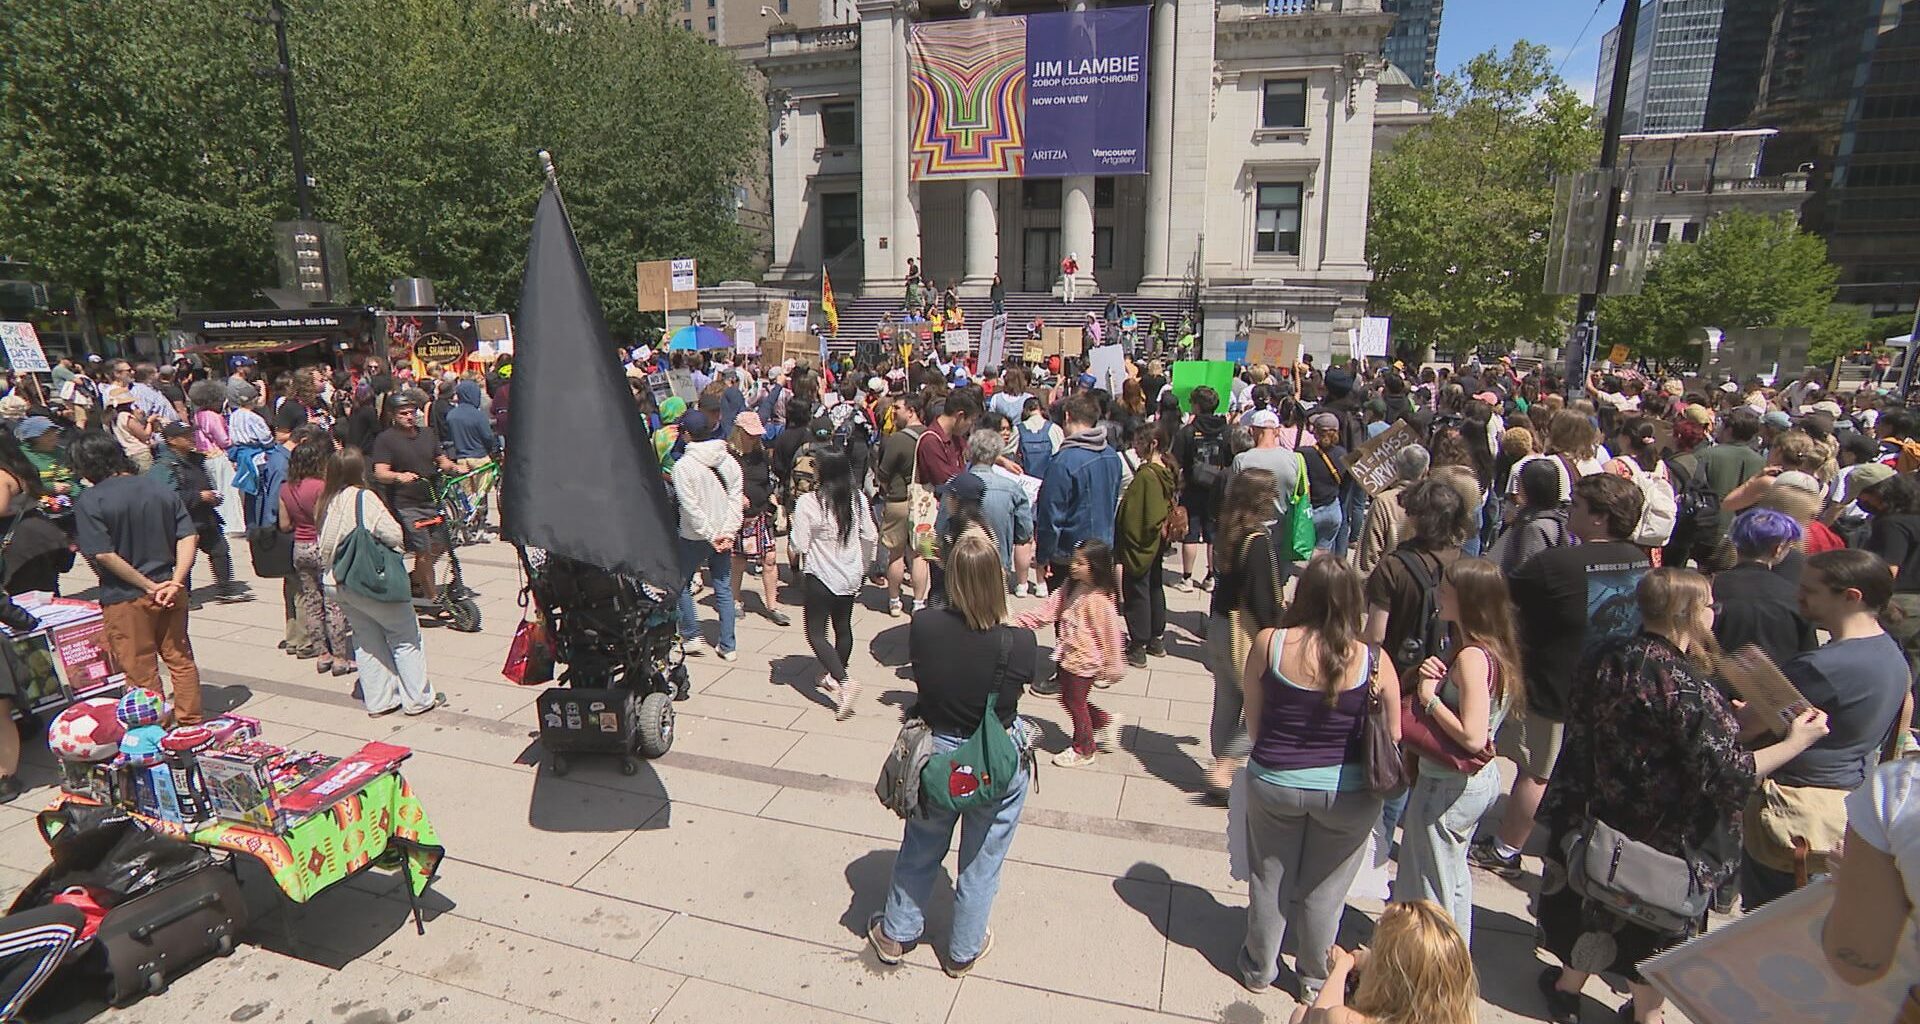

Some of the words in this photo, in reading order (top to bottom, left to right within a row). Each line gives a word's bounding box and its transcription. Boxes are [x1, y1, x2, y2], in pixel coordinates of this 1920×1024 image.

[1032, 61, 1062, 78] JIM
[1068, 56, 1139, 76] LAMBIE
[1032, 78, 1060, 87] ZOBOP
[1061, 74, 1139, 86] (COLOUR-CHROME)
[1032, 96, 1053, 106] NOW
[1053, 96, 1065, 105] ON
[1066, 95, 1088, 105] VIEW
[1031, 149, 1068, 161] ARITZIA
[1092, 148, 1136, 158] Vancouver
[790, 302, 800, 310] NO
[9, 348, 39, 359] DATA
[1372, 430, 1409, 461] MASS
